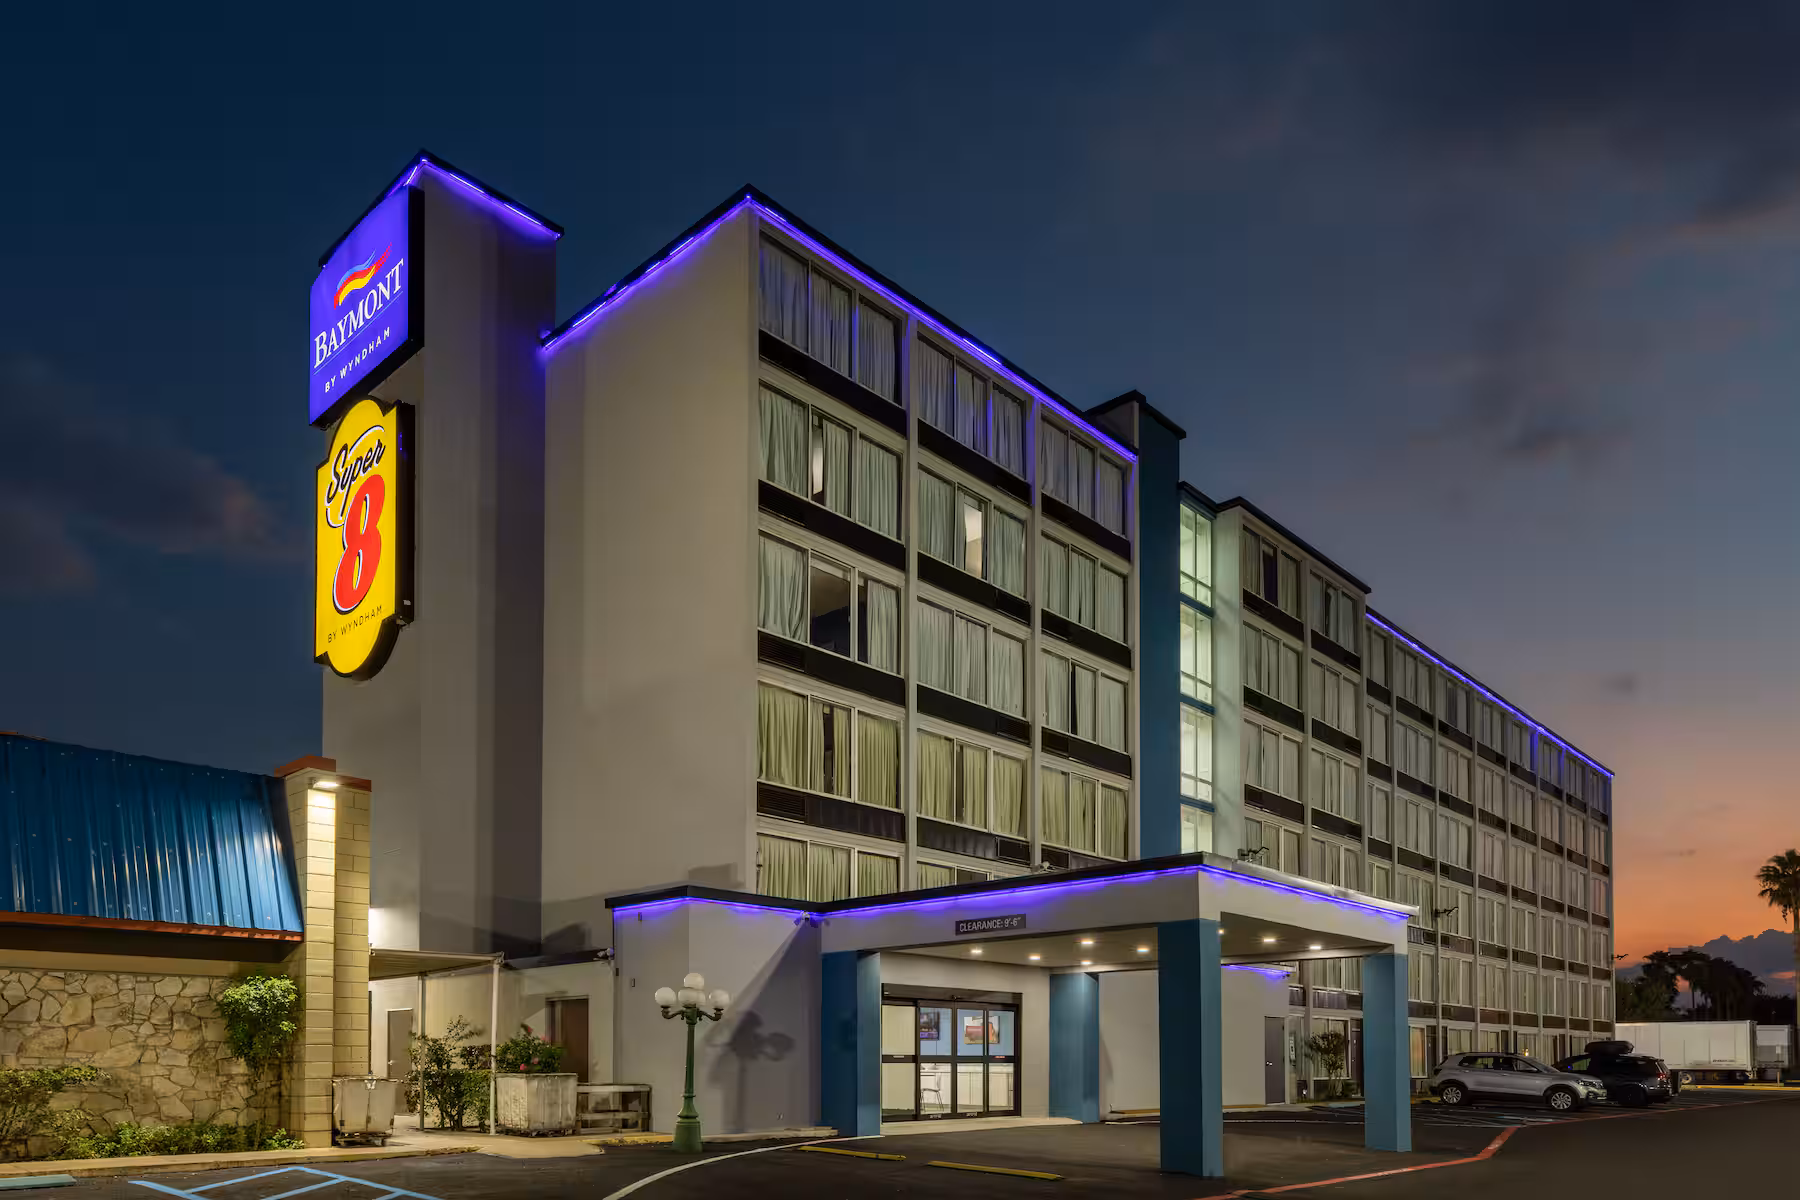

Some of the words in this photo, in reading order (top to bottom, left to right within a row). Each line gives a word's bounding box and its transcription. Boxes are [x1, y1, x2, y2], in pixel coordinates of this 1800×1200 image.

[313, 258, 404, 369] BAYMONT
[325, 375, 336, 393] BY
[340, 326, 391, 379] WYNDHAM
[325, 426, 386, 524] Super
[333, 473, 386, 615] 8
[327, 631, 338, 643] BY
[340, 605, 383, 634] WYNDHAM
[960, 919, 1003, 932] CLEARANCE:
